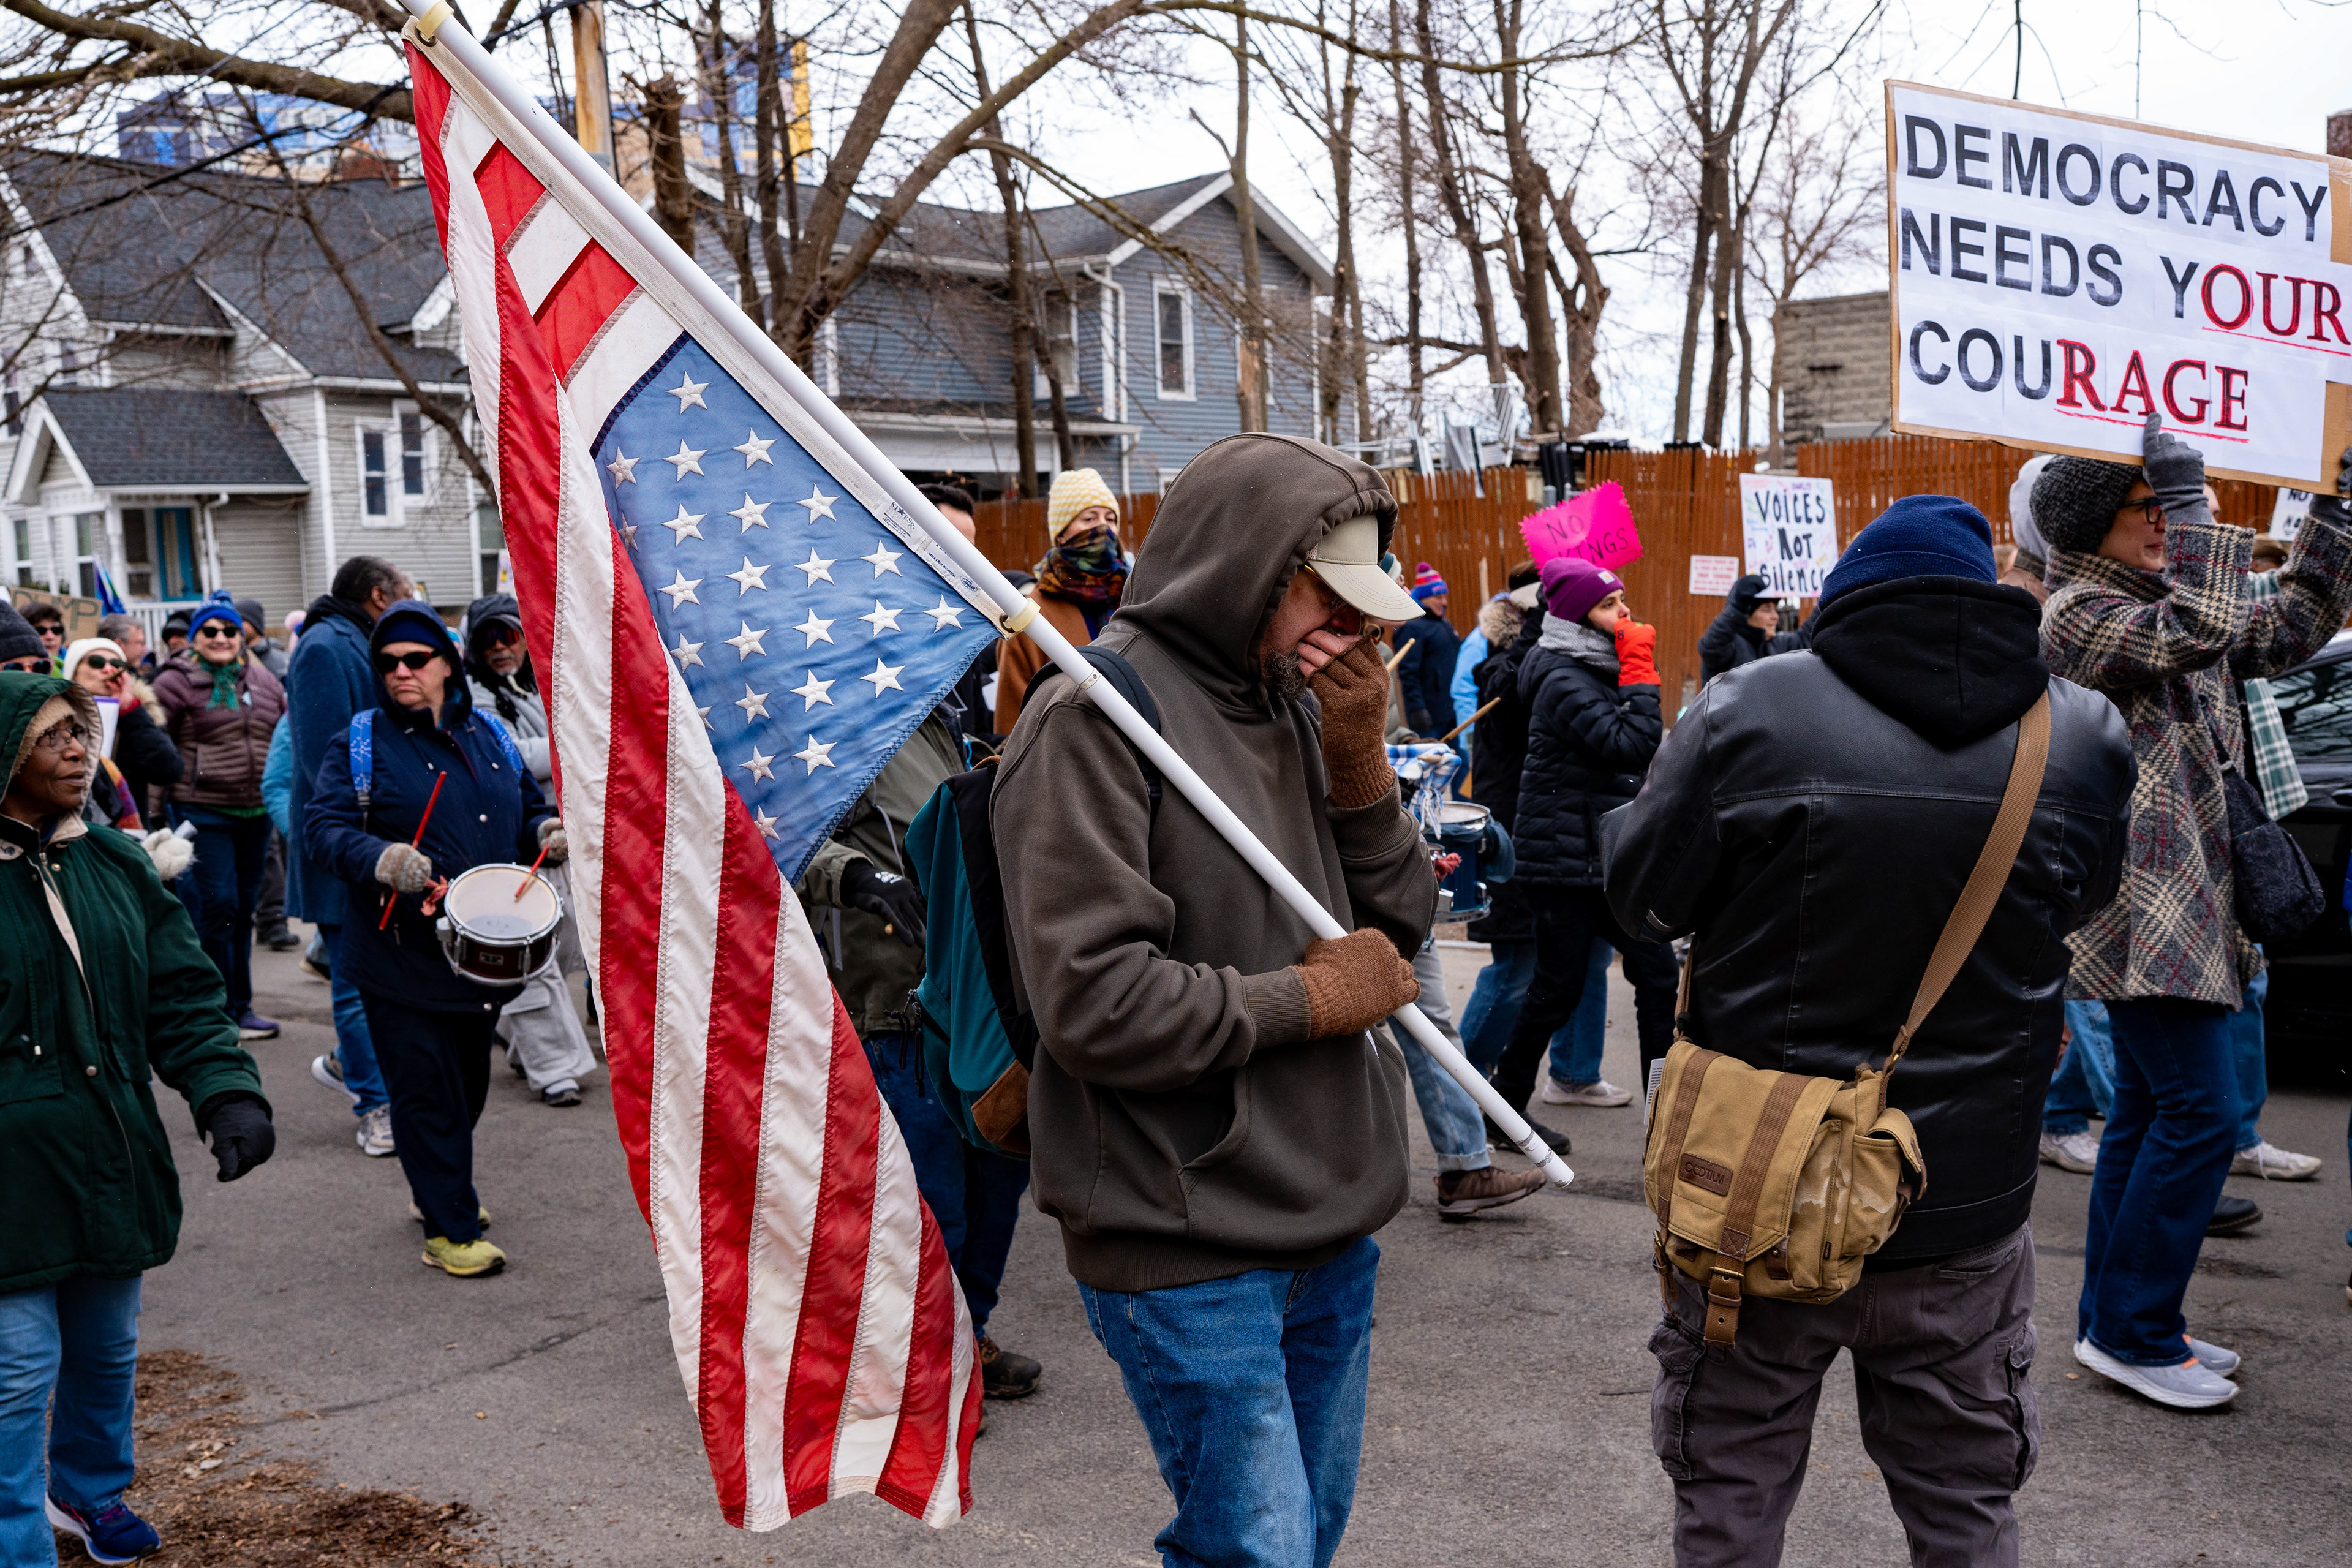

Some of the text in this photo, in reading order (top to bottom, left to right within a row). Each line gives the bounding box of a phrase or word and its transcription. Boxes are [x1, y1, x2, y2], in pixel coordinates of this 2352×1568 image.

[1905, 114, 2328, 242] DEMOCRACY
[1901, 207, 2351, 345] NEEDS YOUR
[1909, 320, 2249, 432] COURAGE
[1547, 514, 1585, 544] NO
[929, 552, 943, 566] VALLEY
[943, 565, 956, 578] FORGE
[1685, 1161, 1725, 1186] GOOTIUM
